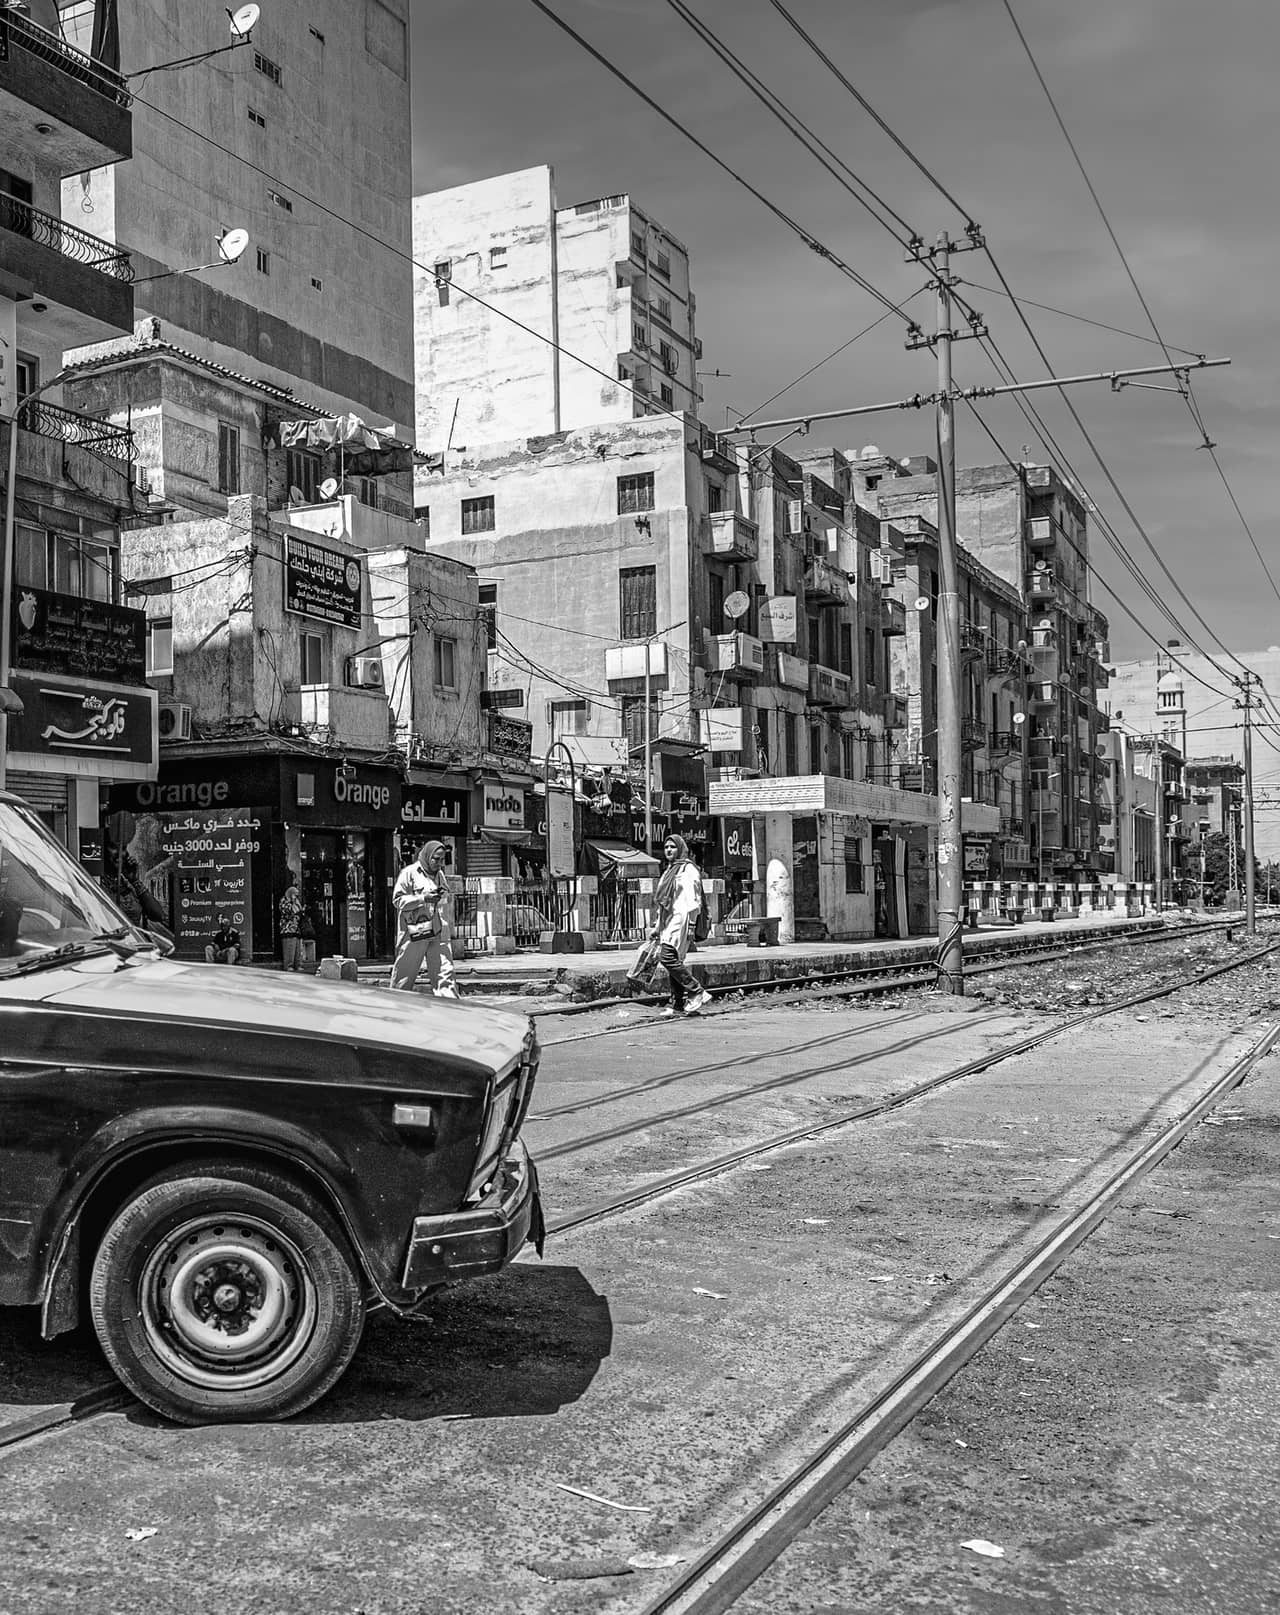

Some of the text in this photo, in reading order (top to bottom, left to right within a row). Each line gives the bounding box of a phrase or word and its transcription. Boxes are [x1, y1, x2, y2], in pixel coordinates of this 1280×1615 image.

[136, 780, 230, 807] Orange
[334, 777, 390, 810] Orange
[163, 817, 262, 834] جدد فري ماكس
[633, 822, 666, 842] TOMY
[162, 838, 261, 856] ووفر لحد 3000 جنيه
[215, 859, 245, 873] في
